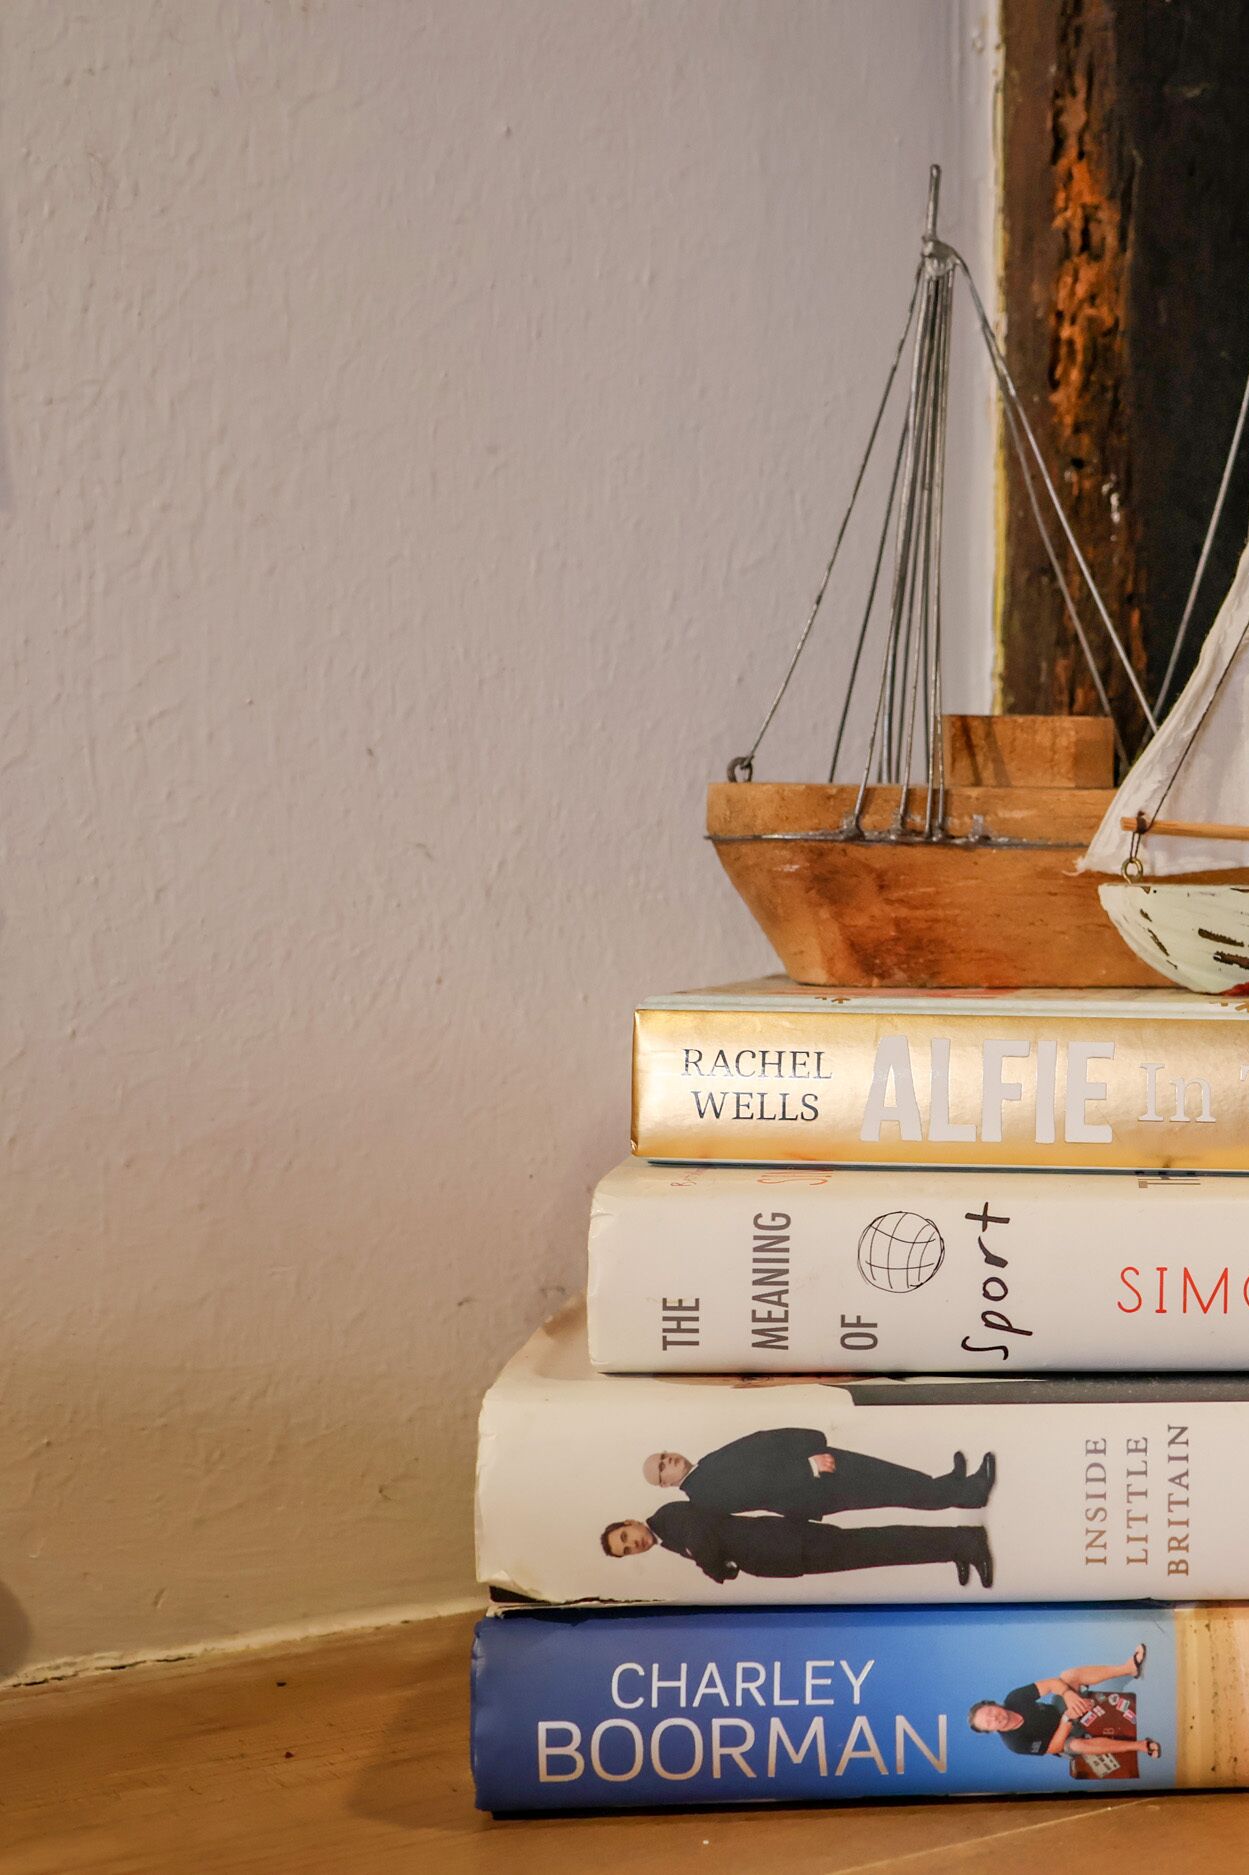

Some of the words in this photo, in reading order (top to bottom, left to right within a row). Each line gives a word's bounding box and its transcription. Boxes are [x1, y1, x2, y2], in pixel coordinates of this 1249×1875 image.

[682, 1047, 833, 1081] RACHEL
[860, 1035, 1115, 1144] ALFIE
[1138, 1062, 1216, 1124] In
[692, 1089, 820, 1122] WELLS
[751, 1210, 792, 1351] MEANING
[662, 1297, 701, 1352] THE
[840, 1313, 879, 1351] OF
[1085, 1436, 1108, 1567] INSIDE
[1126, 1435, 1149, 1567] LITTLE
[1166, 1423, 1190, 1577] BRITAIN
[610, 1659, 876, 1710] CHARLEY
[536, 1713, 950, 1784] BOORMAN
